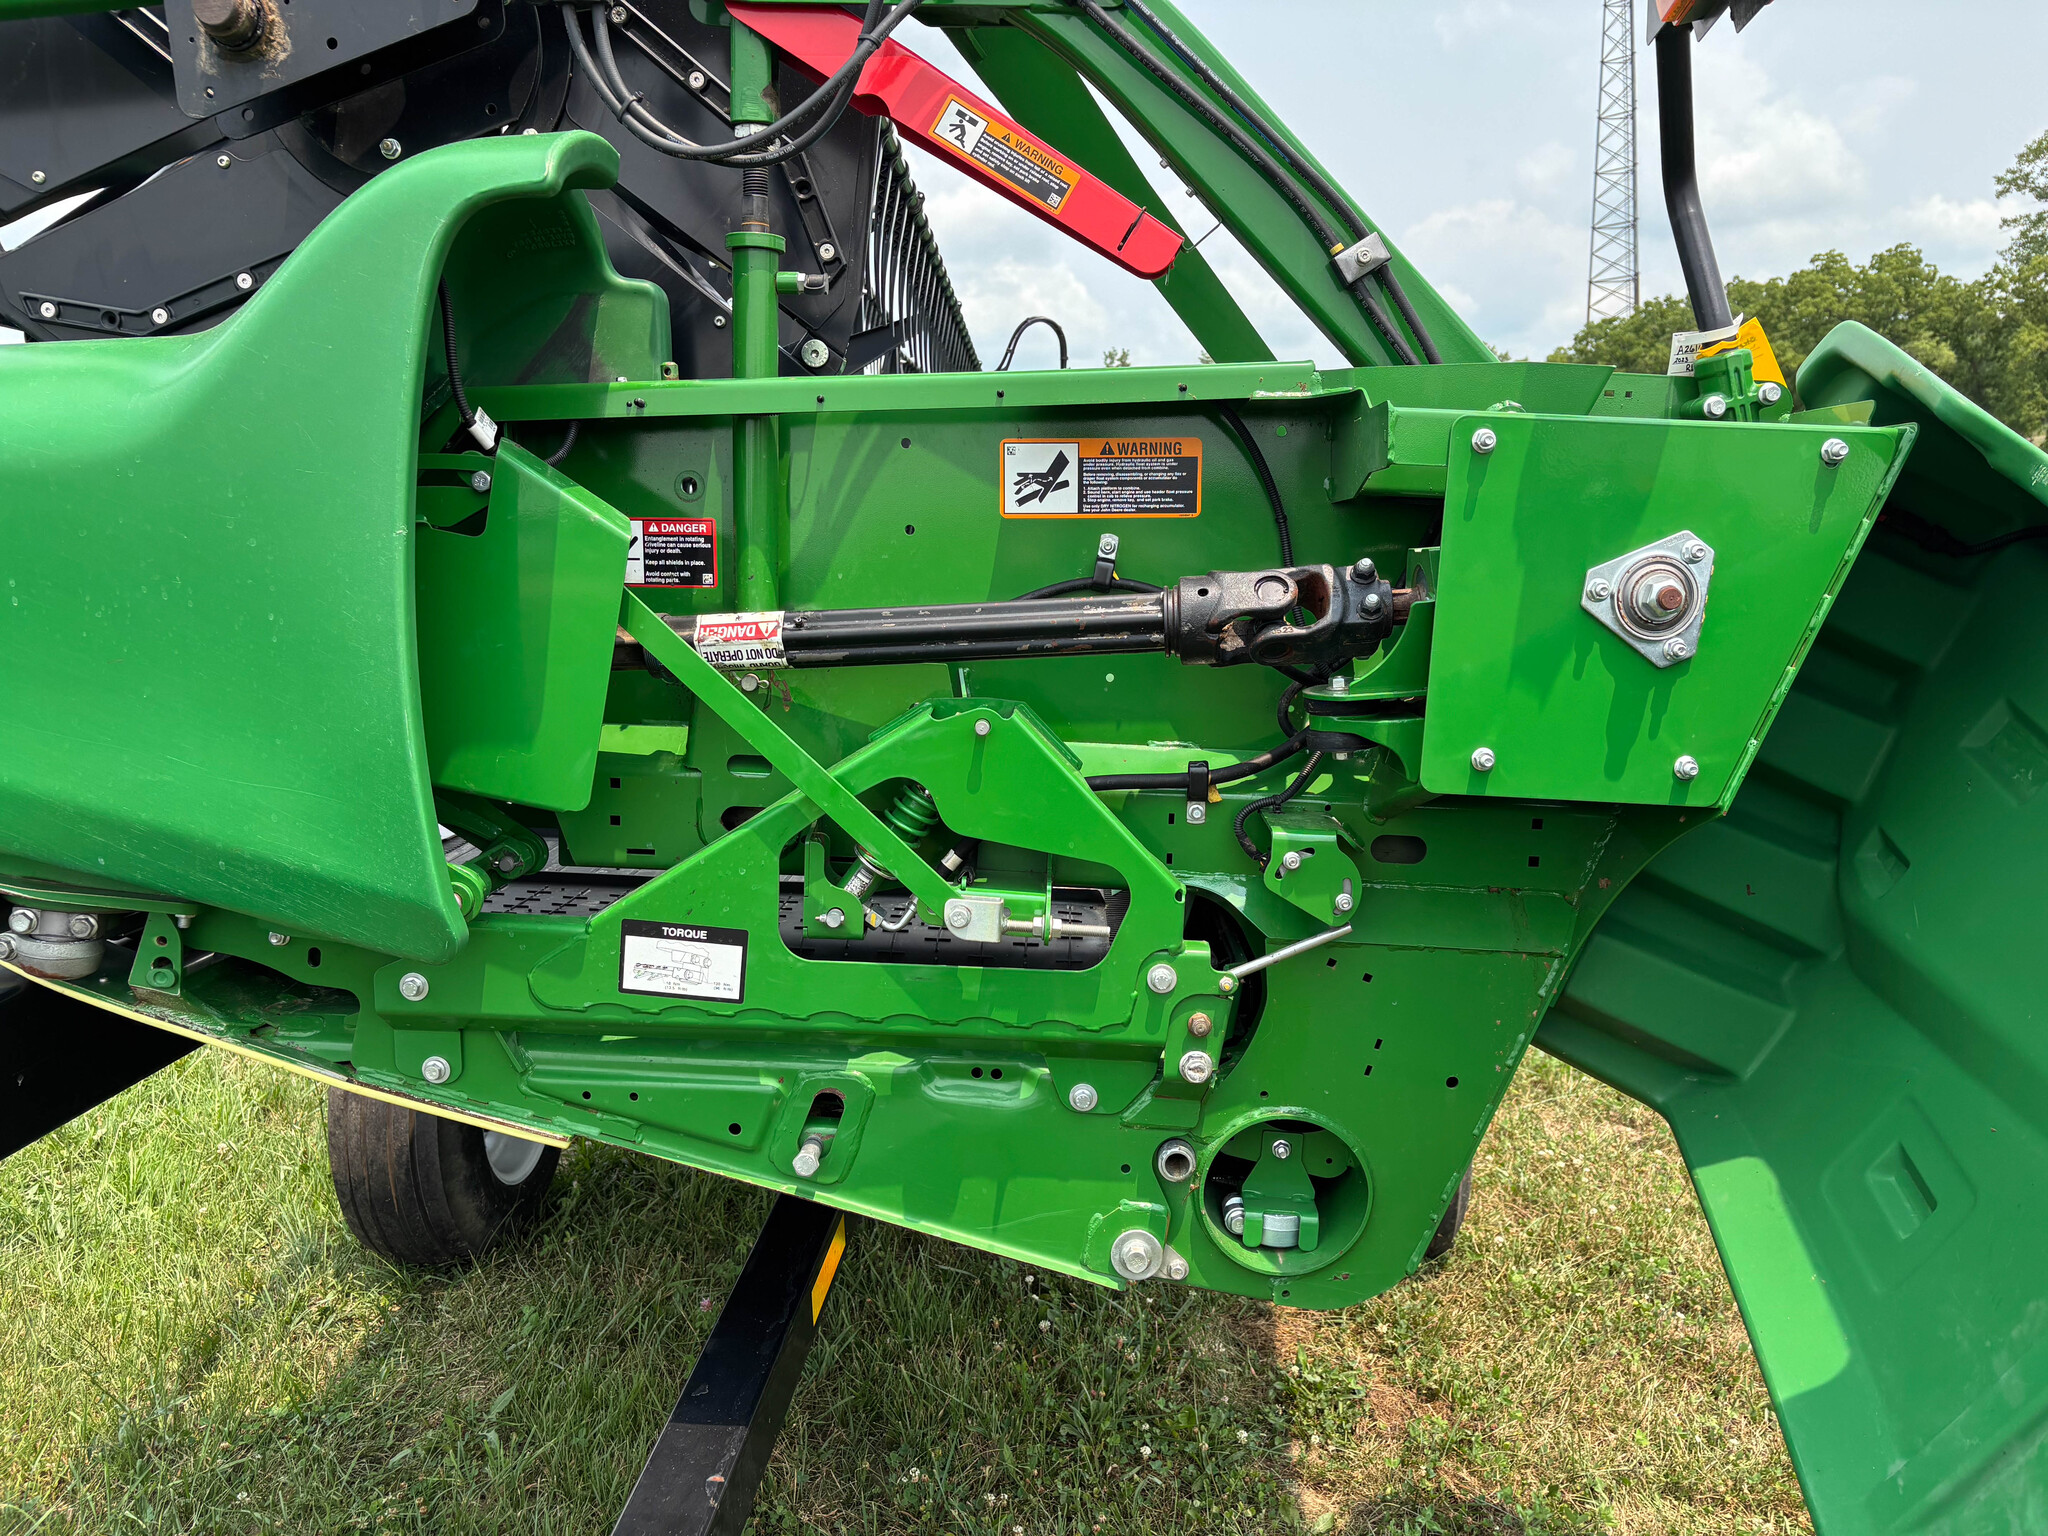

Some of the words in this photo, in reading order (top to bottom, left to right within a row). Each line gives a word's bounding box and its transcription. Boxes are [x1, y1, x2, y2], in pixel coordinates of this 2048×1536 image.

[1015, 138, 1064, 175] WARNING
[1117, 441, 1182, 455] WARNING
[661, 524, 707, 533] DANGER
[700, 624, 756, 638] DANGER
[703, 649, 743, 662] OPERATE
[746, 648, 764, 660] NOT
[764, 647, 778, 659] DO
[662, 927, 708, 940] TORQUE
